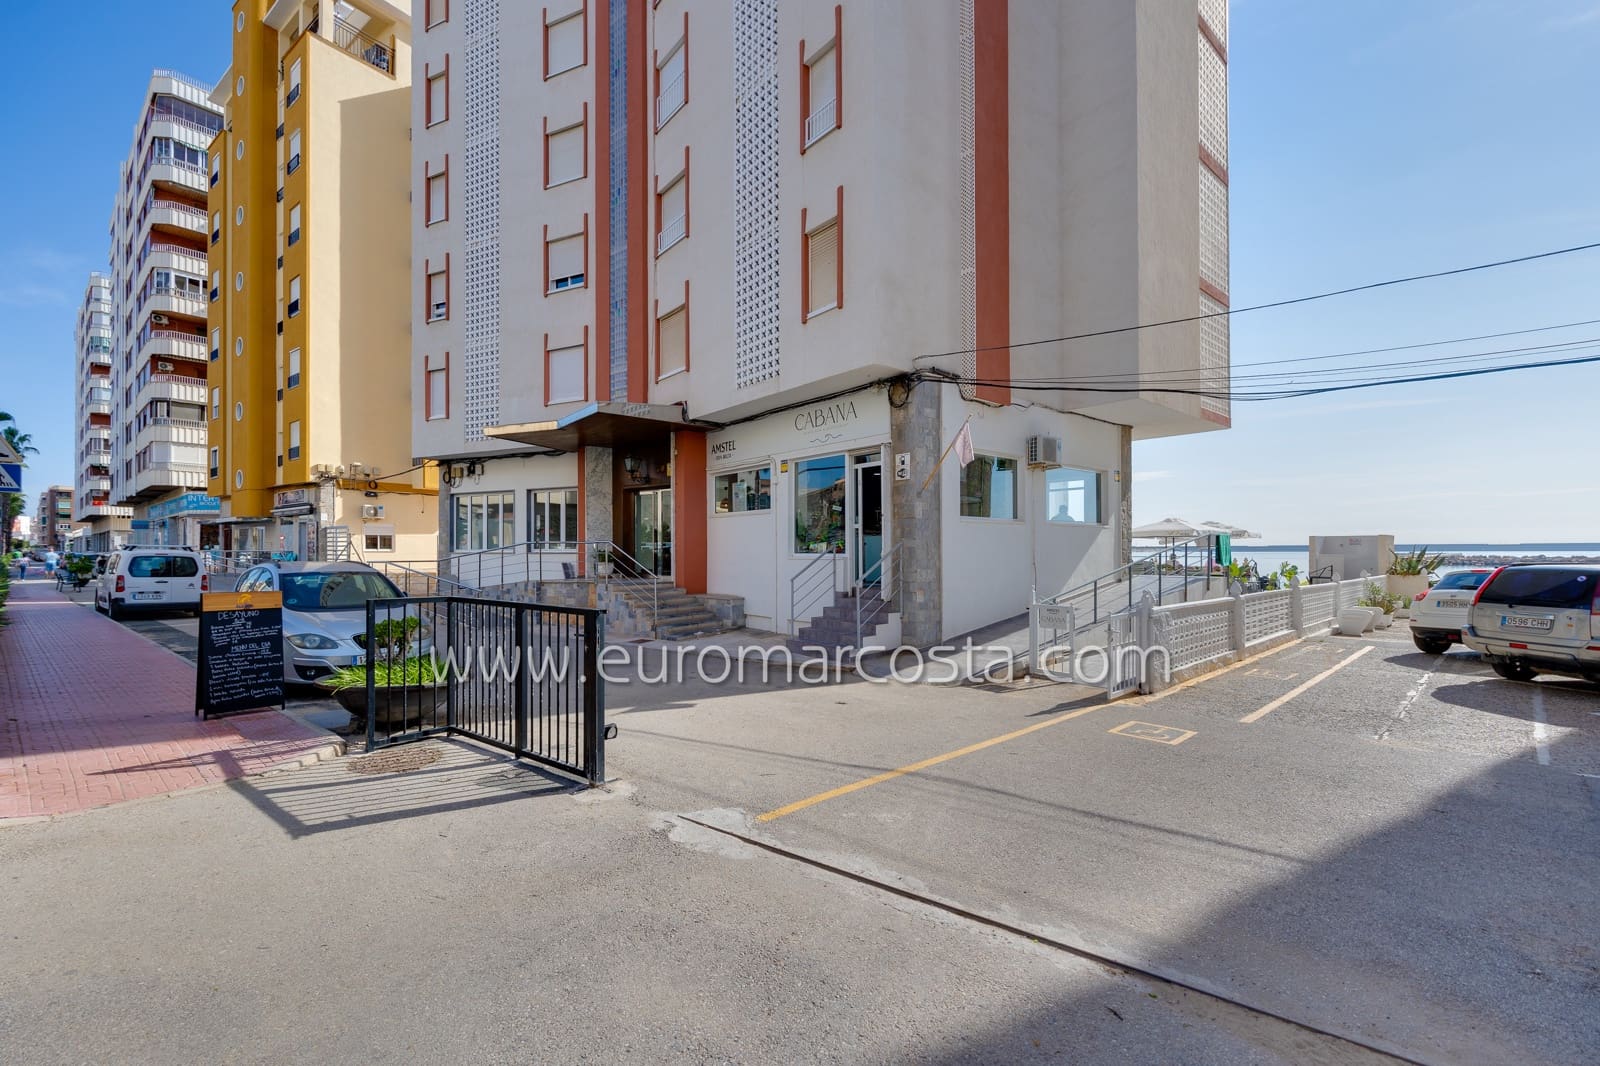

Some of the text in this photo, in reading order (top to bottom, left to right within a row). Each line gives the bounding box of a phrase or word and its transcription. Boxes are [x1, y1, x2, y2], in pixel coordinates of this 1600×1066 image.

[794, 401, 857, 431] CABANA
[711, 439, 737, 455] AMSTEL
[217, 609, 260, 621] DESAYUNO
[1507, 617, 1549, 628] 0596 CHH
